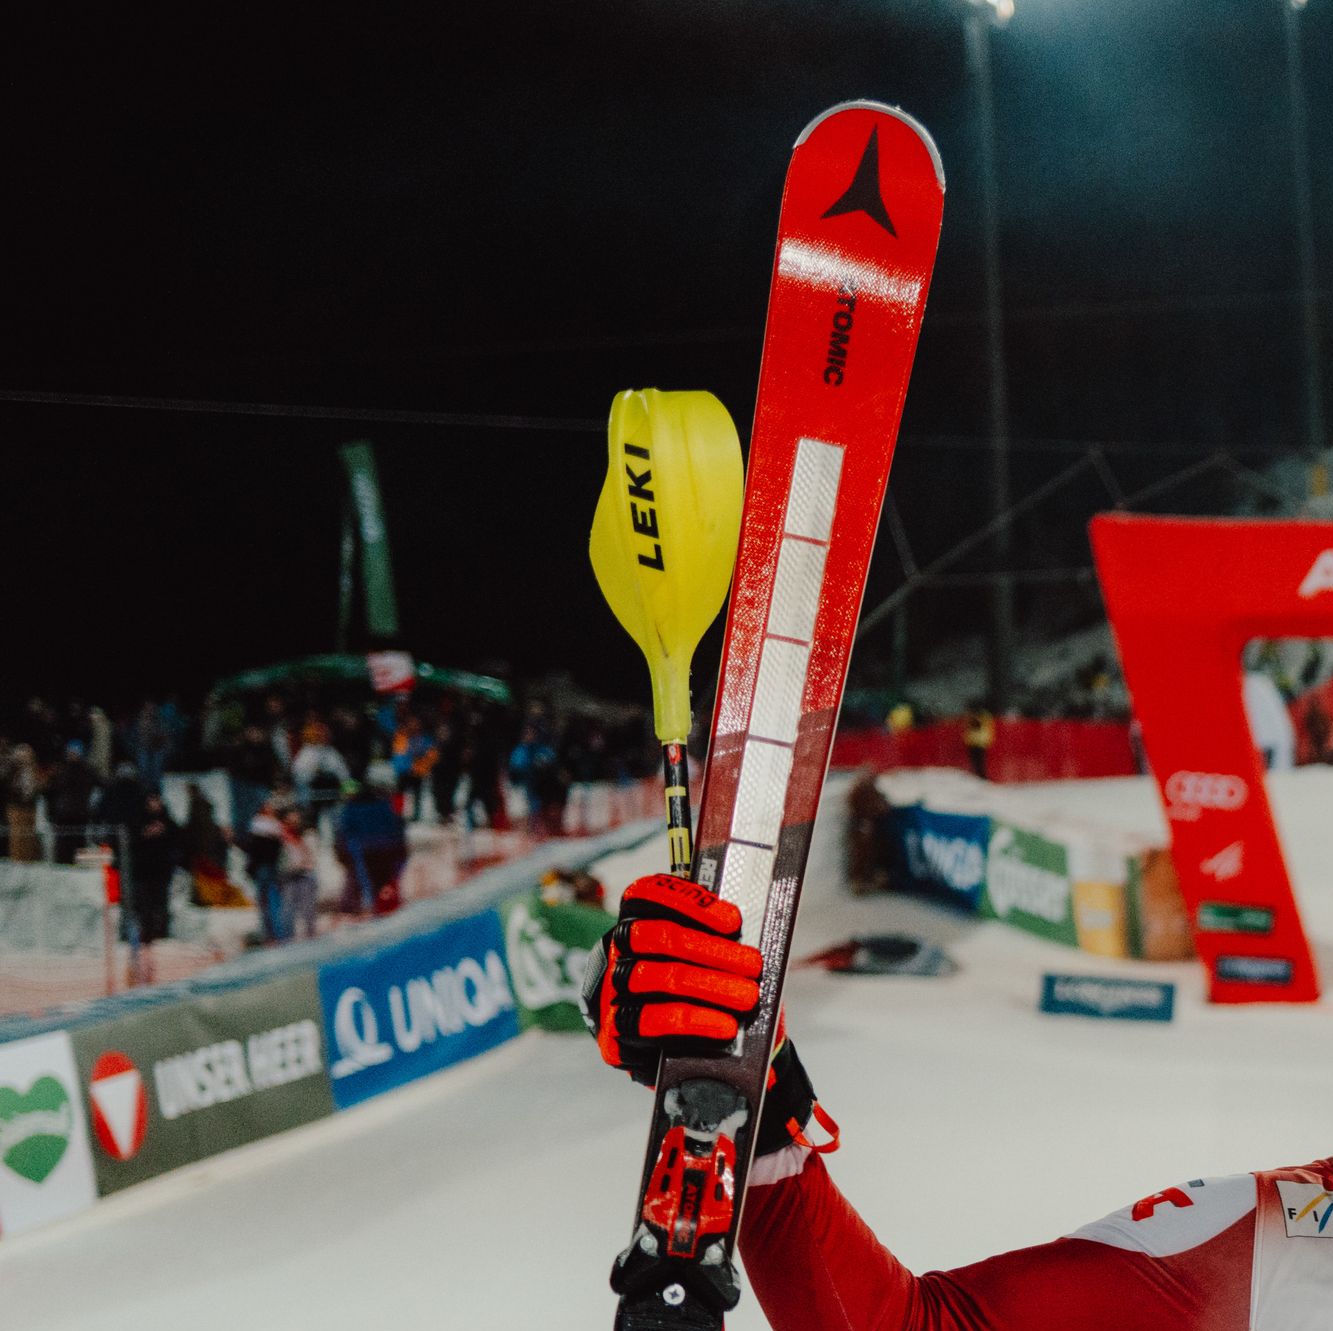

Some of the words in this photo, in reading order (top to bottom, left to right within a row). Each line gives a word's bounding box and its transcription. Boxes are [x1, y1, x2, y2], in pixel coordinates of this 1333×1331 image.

[624, 443, 665, 572] LEKI
[155, 1038, 251, 1121] UNSER
[248, 1019, 322, 1086] HEER
